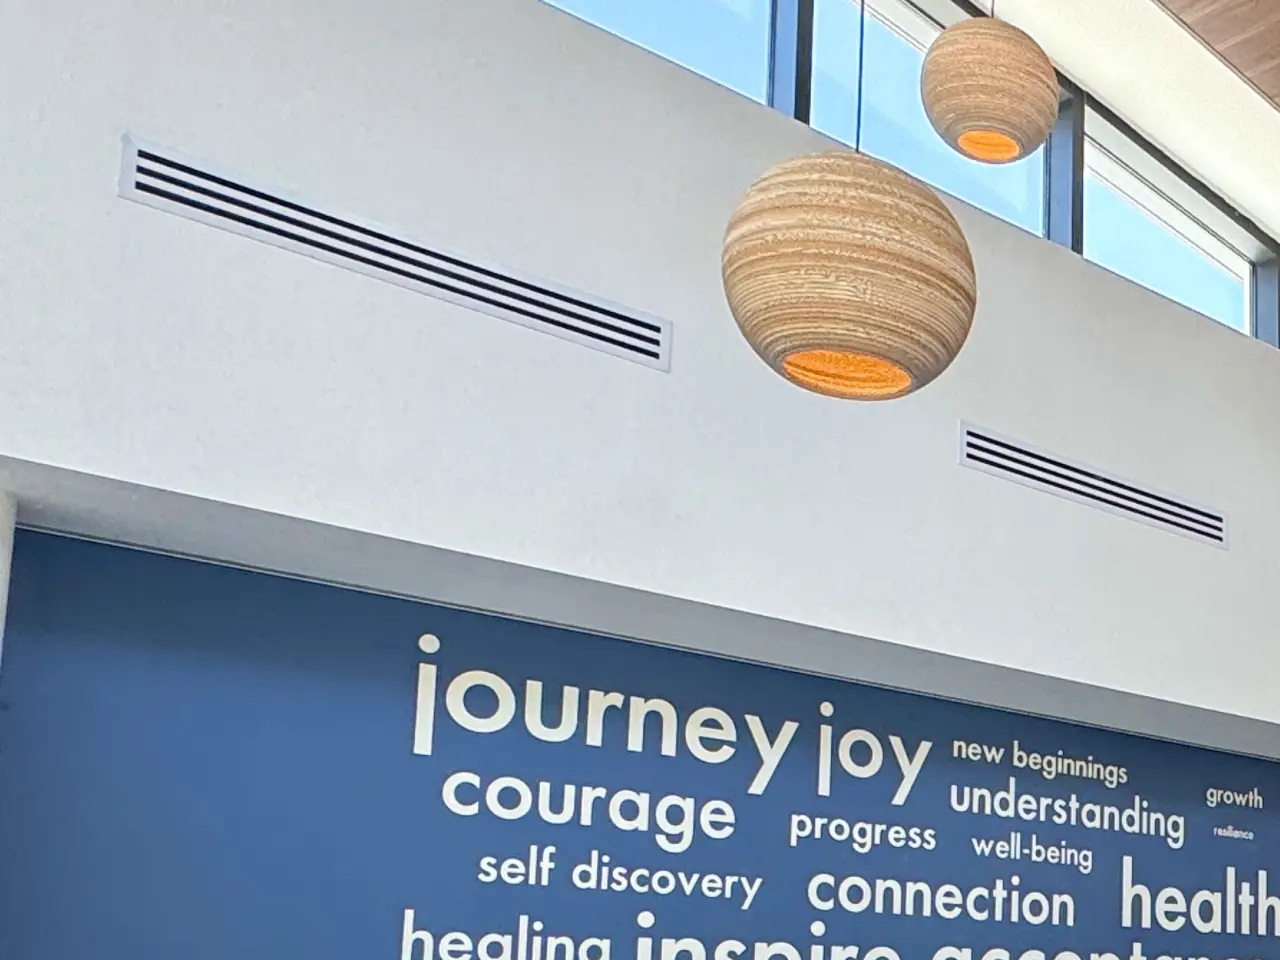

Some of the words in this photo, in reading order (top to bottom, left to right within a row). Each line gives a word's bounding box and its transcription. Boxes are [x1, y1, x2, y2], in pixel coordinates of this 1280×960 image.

[413, 633, 800, 796] journey
[817, 701, 933, 806] joy
[952, 740, 1005, 764] new
[1012, 740, 1128, 789] beginnings
[441, 771, 736, 854] courage
[950, 776, 1185, 849] understanding
[1206, 787, 1263, 809] growth
[789, 813, 937, 854] progress
[971, 831, 1093, 875] well-being
[477, 844, 557, 886] self
[571, 849, 763, 911] discovery
[807, 873, 1075, 927] connection
